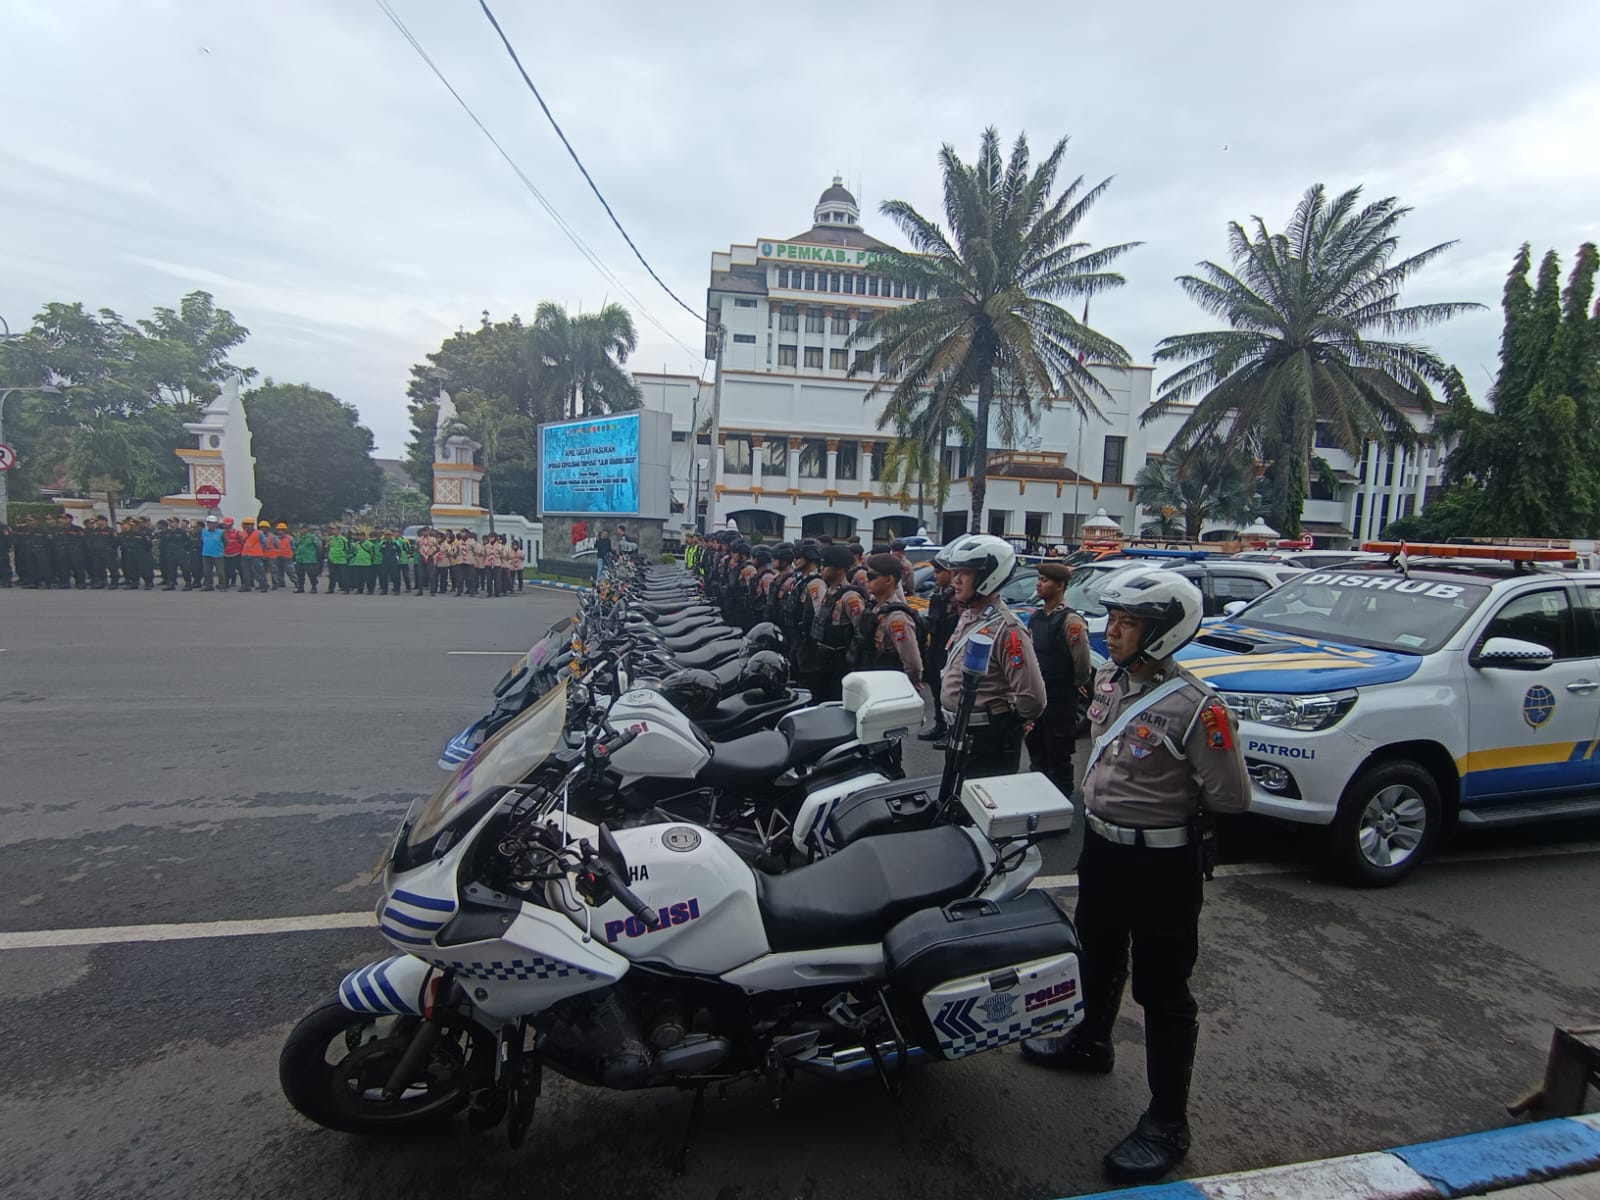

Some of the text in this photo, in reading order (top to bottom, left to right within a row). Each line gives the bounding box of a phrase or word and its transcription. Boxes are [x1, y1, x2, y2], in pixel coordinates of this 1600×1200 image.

[776, 244, 851, 263] PEMKAB.
[1302, 574, 1465, 599] DISHUB
[1140, 711, 1167, 727] OLRI
[1248, 740, 1316, 760] PATROLI
